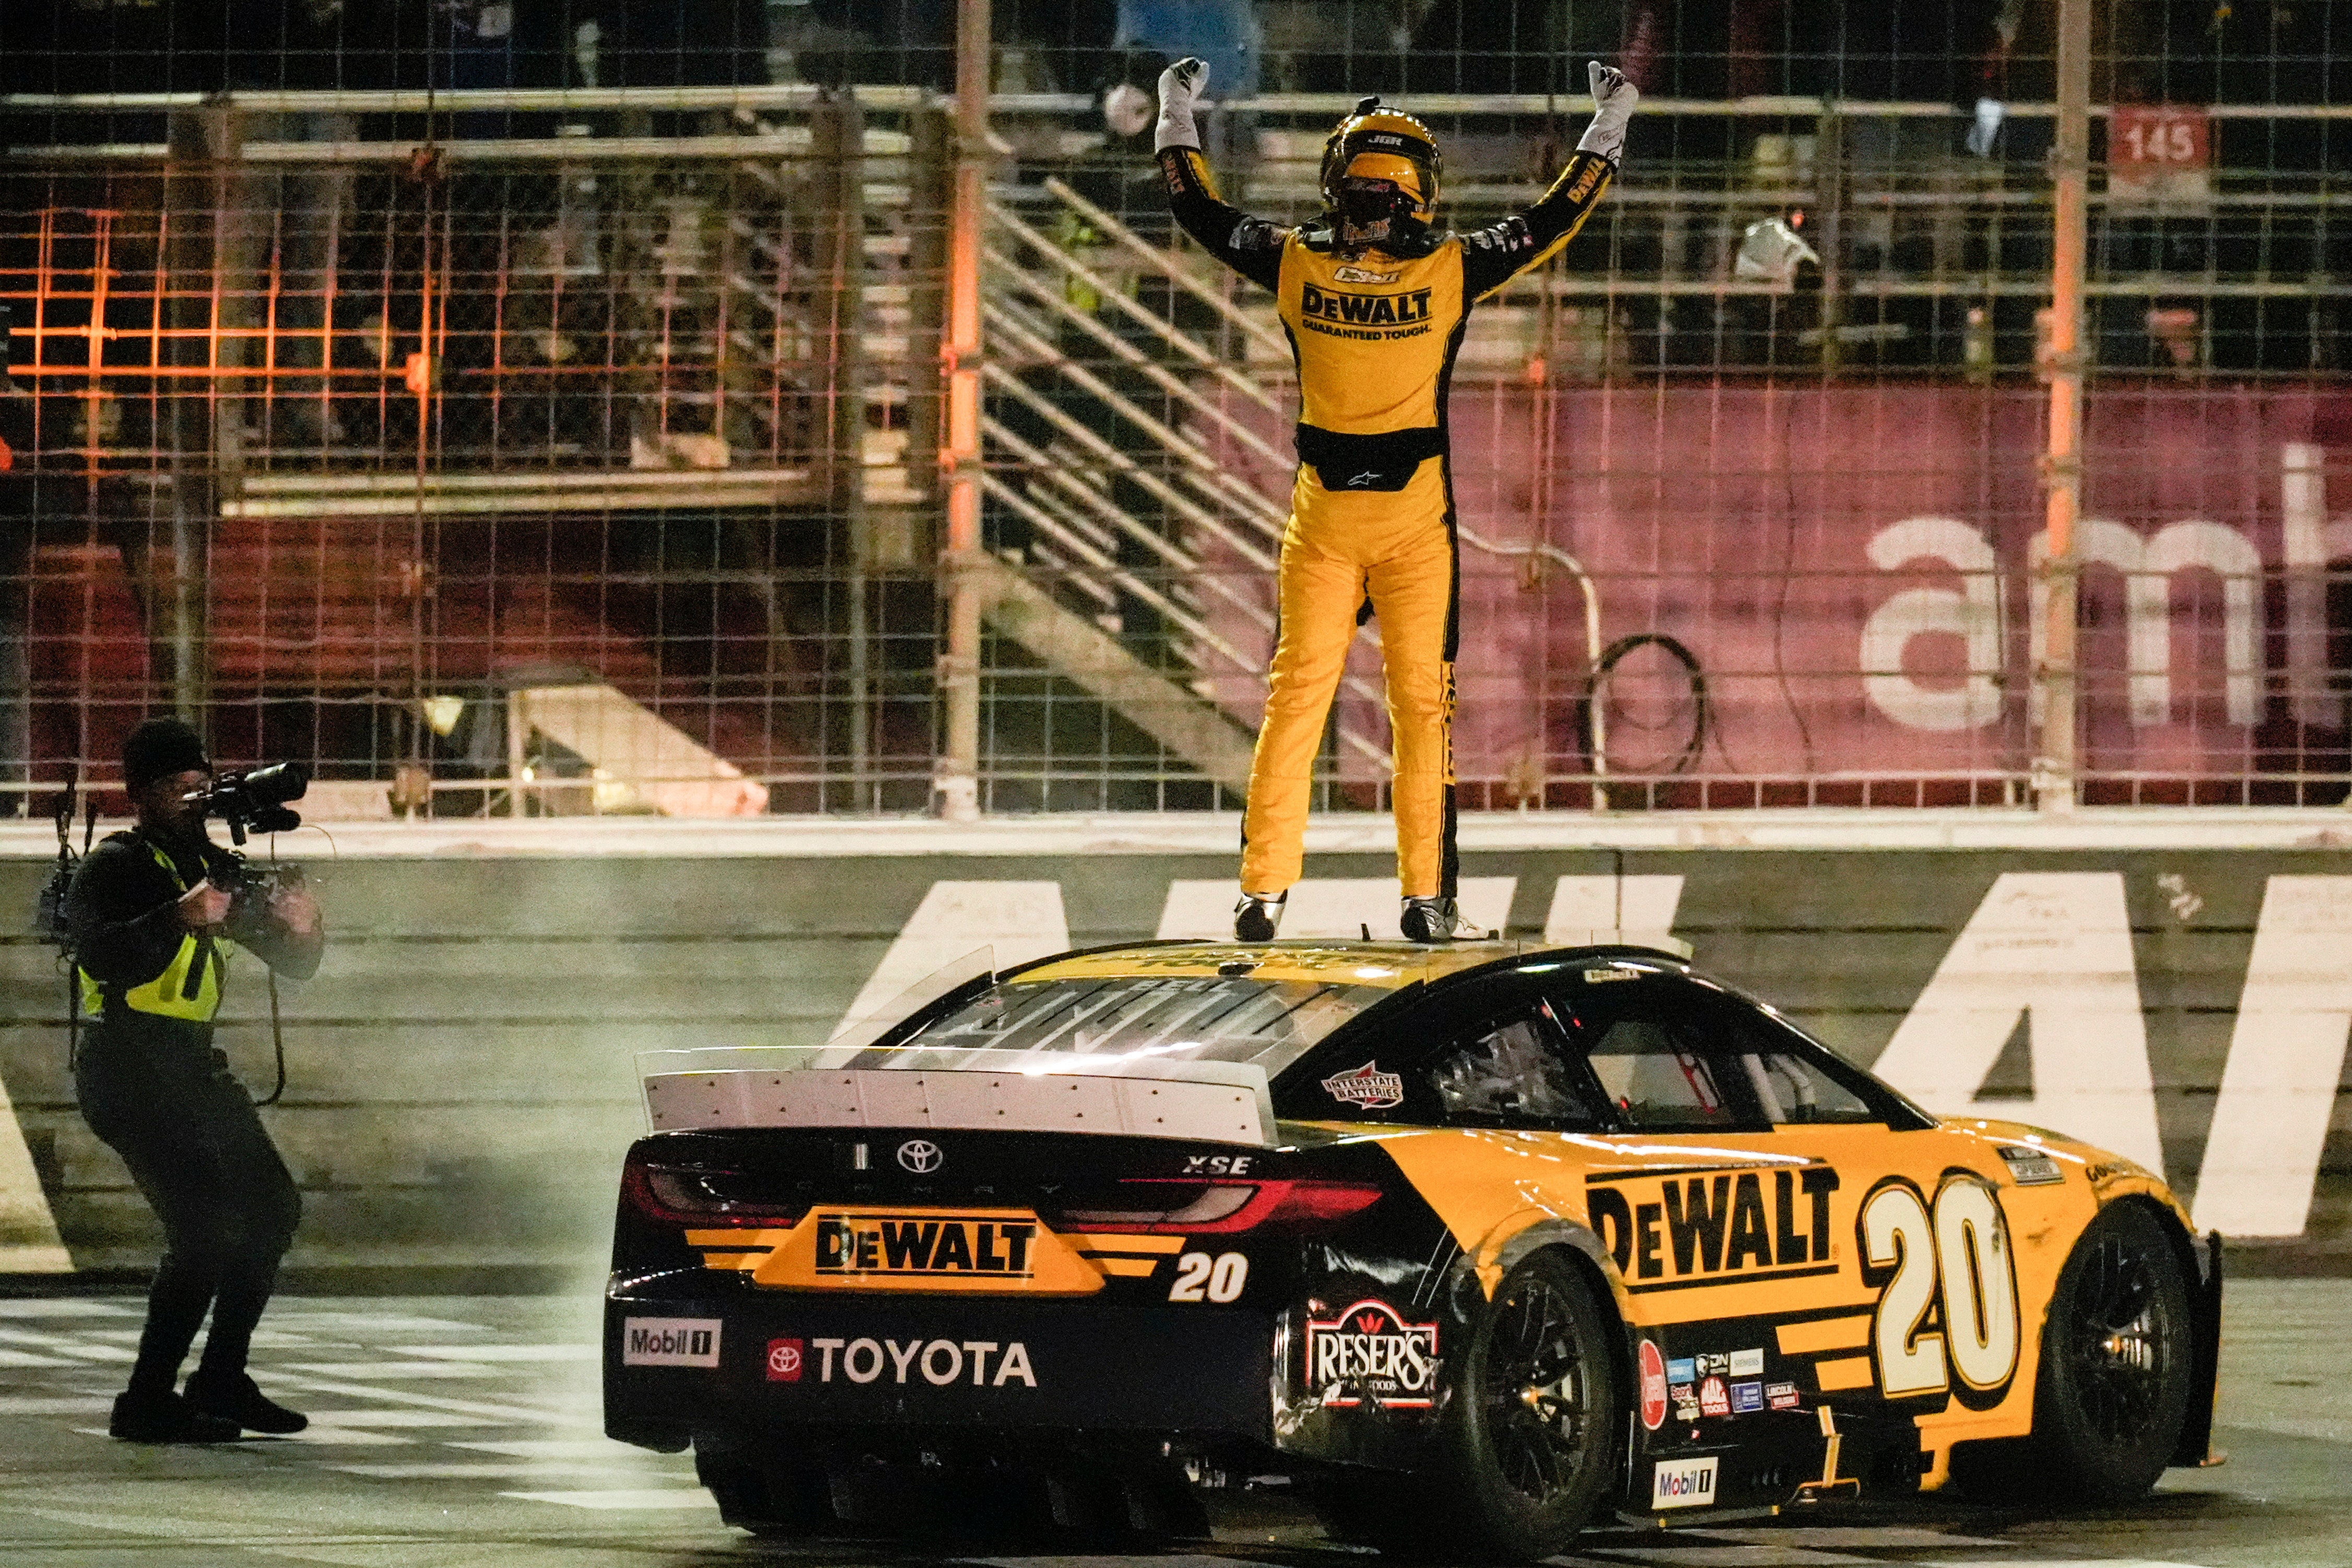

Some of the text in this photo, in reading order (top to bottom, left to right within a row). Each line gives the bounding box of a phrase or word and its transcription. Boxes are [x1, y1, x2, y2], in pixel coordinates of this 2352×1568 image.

[2126, 124, 2194, 161] 145
[1301, 286, 1432, 323] DEWALT
[1302, 319, 1382, 340] GUARANTEED
[1324, 1076, 1399, 1090] INTERSTATE
[1337, 1087, 1401, 1099] BATTERIES
[1182, 1156, 1253, 1175] XSE
[1585, 1166, 1841, 1279] DEWALT
[815, 1221, 1036, 1271] DEWALT
[1168, 1252, 1249, 1303] 20
[1861, 1173, 2019, 1400] 20
[631, 1328, 688, 1354] Mobil
[812, 1337, 1038, 1387] TOYOTA
[1317, 1331, 1426, 1390] RESER'S
[1767, 1384, 1793, 1397] LINCOLN
[1659, 1470, 1697, 1498] Mobil
